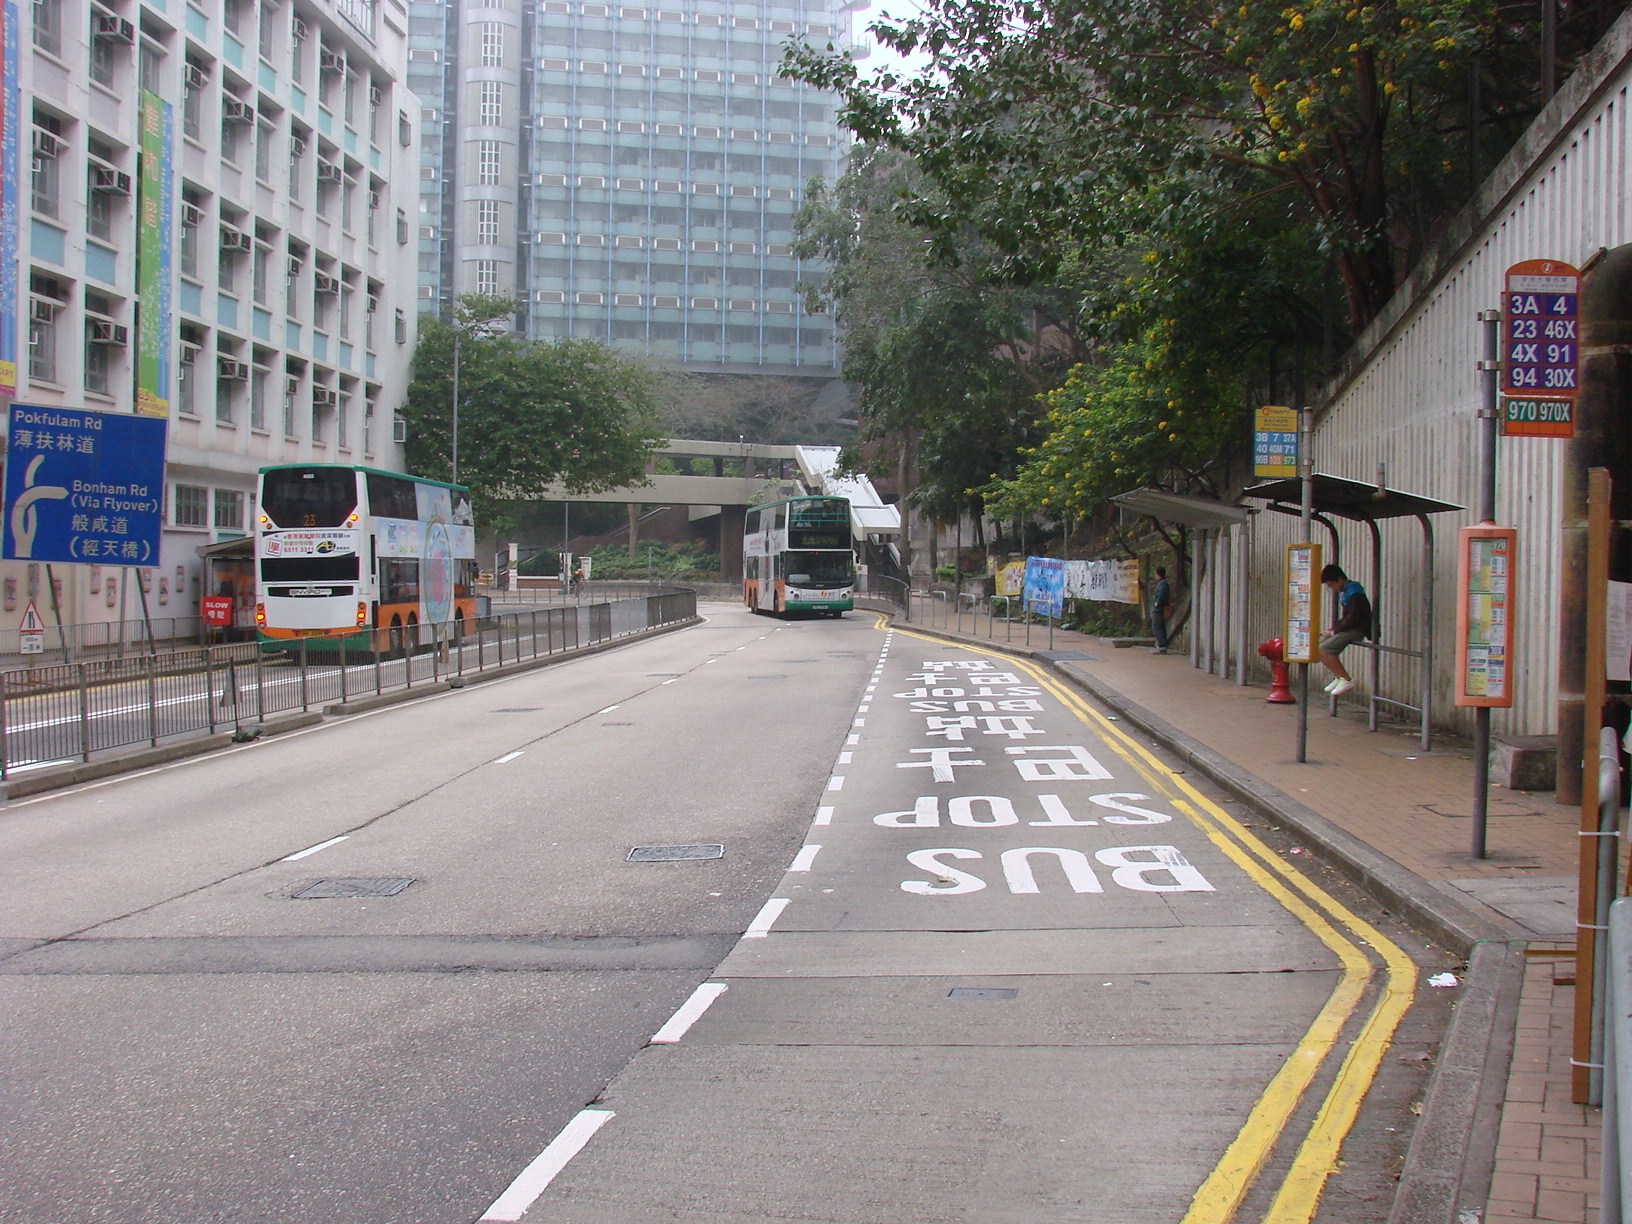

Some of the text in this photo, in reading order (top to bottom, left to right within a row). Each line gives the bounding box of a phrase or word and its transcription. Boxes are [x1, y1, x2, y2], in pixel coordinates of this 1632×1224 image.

[1511, 296, 1567, 315] 3A 4
[1513, 320, 1576, 339] 23 46X
[1511, 344, 1570, 363] 4X 91
[1512, 368, 1576, 388] 94 30X
[15, 410, 103, 430] Pokfulam Rd
[1509, 401, 1570, 422] 970 970X
[14, 429, 95, 454] 薄扶林道
[1273, 433, 1279, 442] 7
[1283, 433, 1296, 443] 37A
[1256, 444, 1268, 453] 40
[1283, 445, 1295, 454] 71
[1282, 456, 1296, 465] 973
[73, 480, 148, 497] Bonham Rd
[70, 493, 159, 514] (Via Flyover)
[71, 514, 129, 535] 般咸道
[303, 514, 316, 527] 23
[893, 686, 1043, 699] STOP
[908, 699, 1045, 713] BUS
[895, 745, 1115, 783] 巴士
[872, 792, 1173, 828] STOP
[900, 845, 1218, 896] BUS
